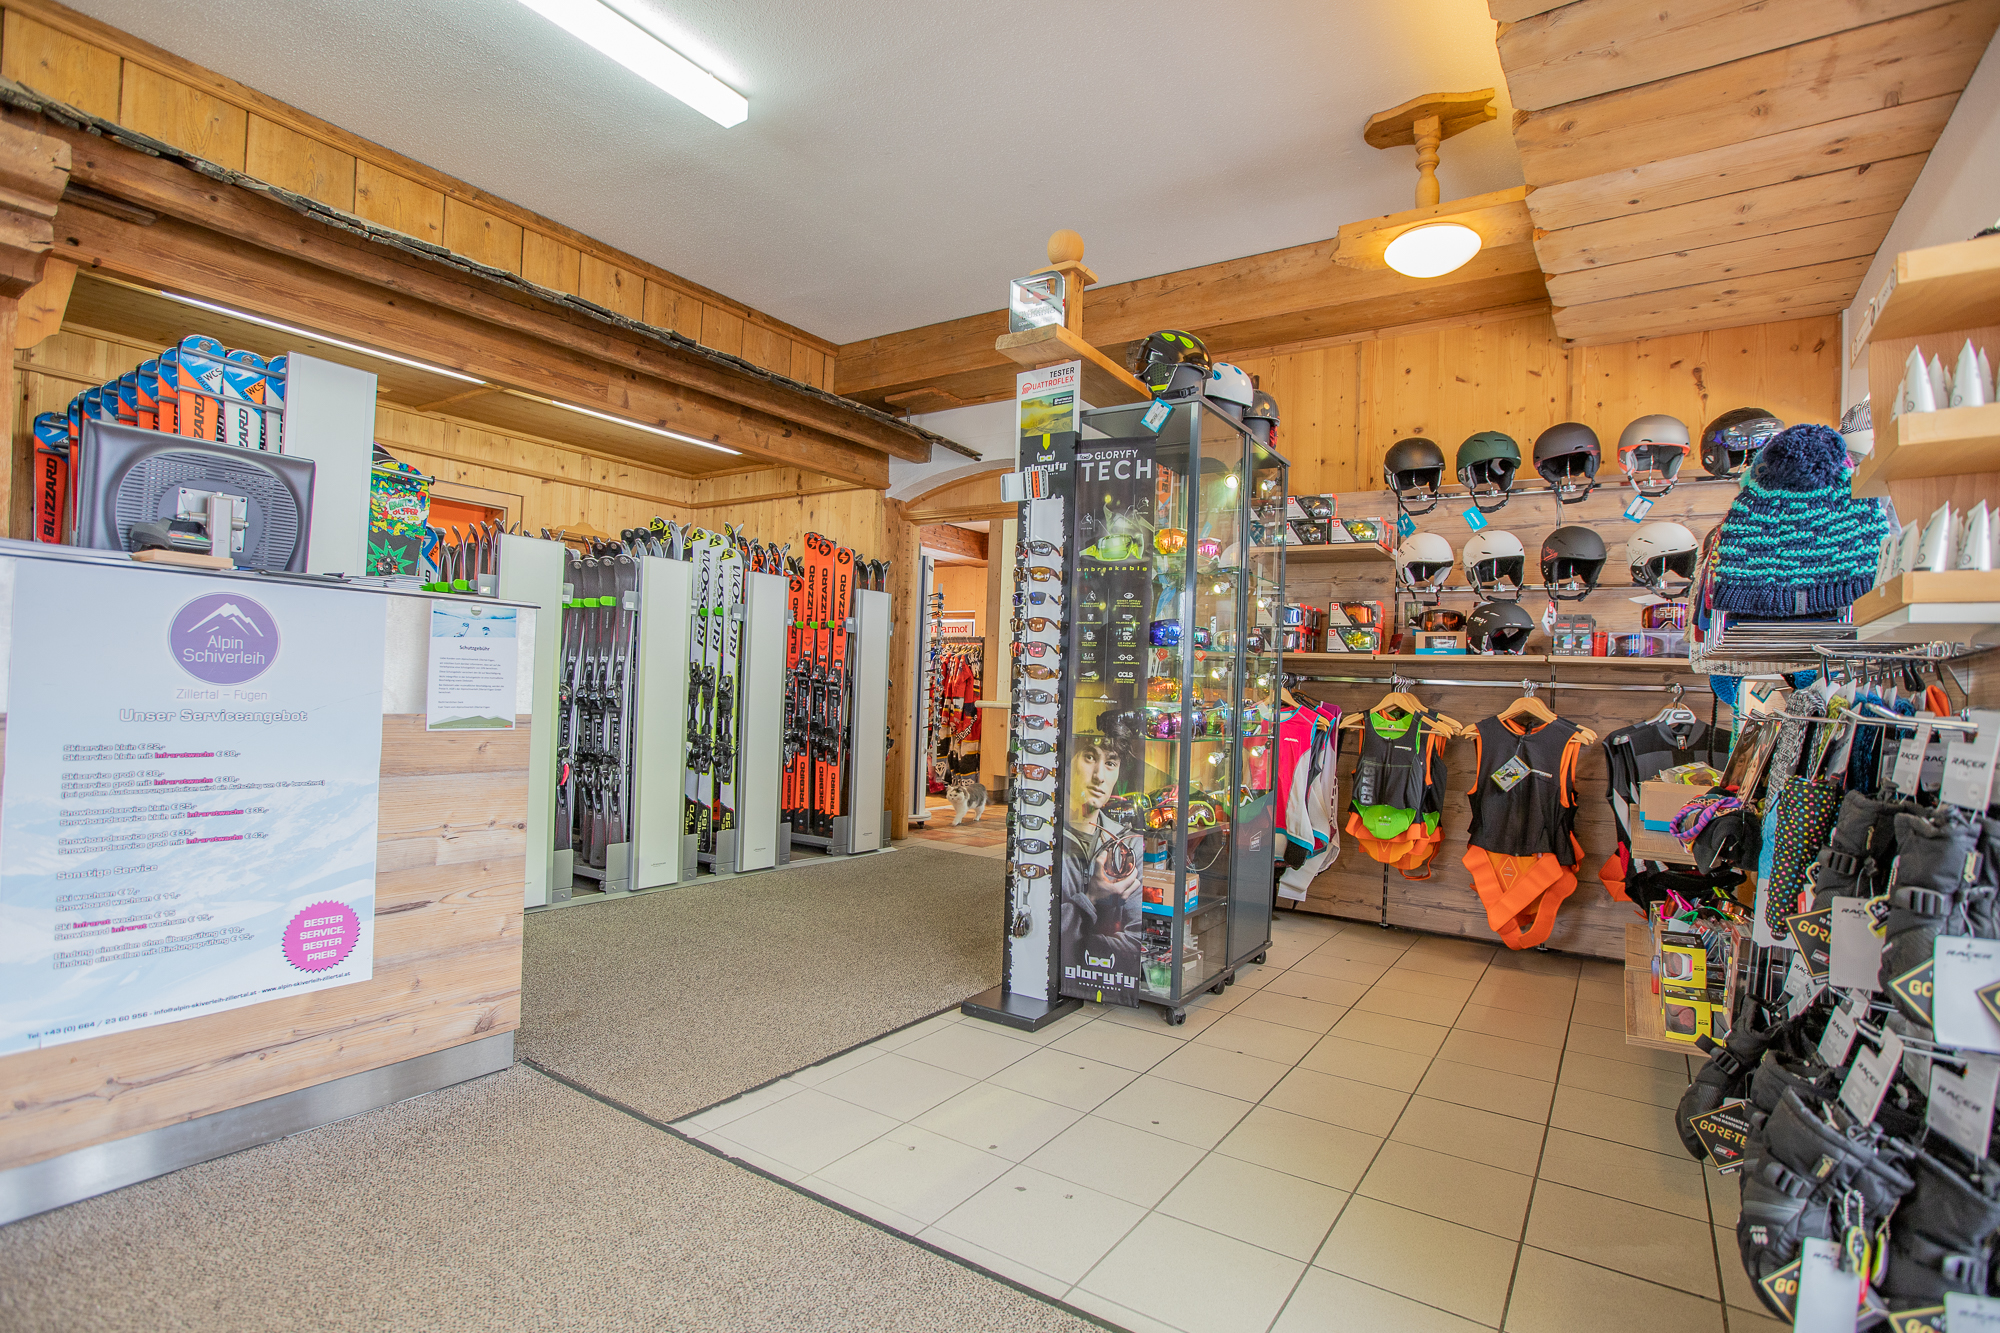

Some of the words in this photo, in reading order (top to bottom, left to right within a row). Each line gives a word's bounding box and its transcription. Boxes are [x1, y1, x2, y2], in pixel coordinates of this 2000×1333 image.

[203, 368, 223, 382] WCS
[1050, 366, 1075, 379] TESTER
[246, 382, 264, 395] WCS
[1094, 449, 1138, 460] GLORYFY
[1081, 459, 1152, 482] TECH
[806, 565, 816, 626] BLIZZARD
[821, 567, 829, 630] BLIZZARD
[837, 574, 847, 636] BLIZZARD
[207, 634, 243, 650] Alpin
[183, 648, 265, 665] Schiverleih
[177, 688, 219, 701] Zillertal
[234, 688, 268, 702] Fügen
[120, 708, 176, 722] Unser
[180, 709, 308, 724] Serviceangebot
[1951, 757, 1987, 769] RACER
[57, 868, 111, 880] Sonstige
[114, 864, 158, 875] Service
[303, 915, 343, 928] BESTER
[300, 926, 345, 940] SERVICE,
[302, 937, 342, 951] BESTER
[307, 949, 337, 962] PREIS
[1064, 965, 1138, 989] gloryfy
[44, 1028, 61, 1036] +43
[63, 1025, 76, 1034] (0)
[78, 1021, 95, 1030] 664
[105, 1017, 116, 1025] 23
[131, 1011, 148, 1020] 956
[1831, 1019, 1849, 1039] RACER
[1857, 1062, 1880, 1087] RACER
[1937, 1084, 1982, 1112] RACER
